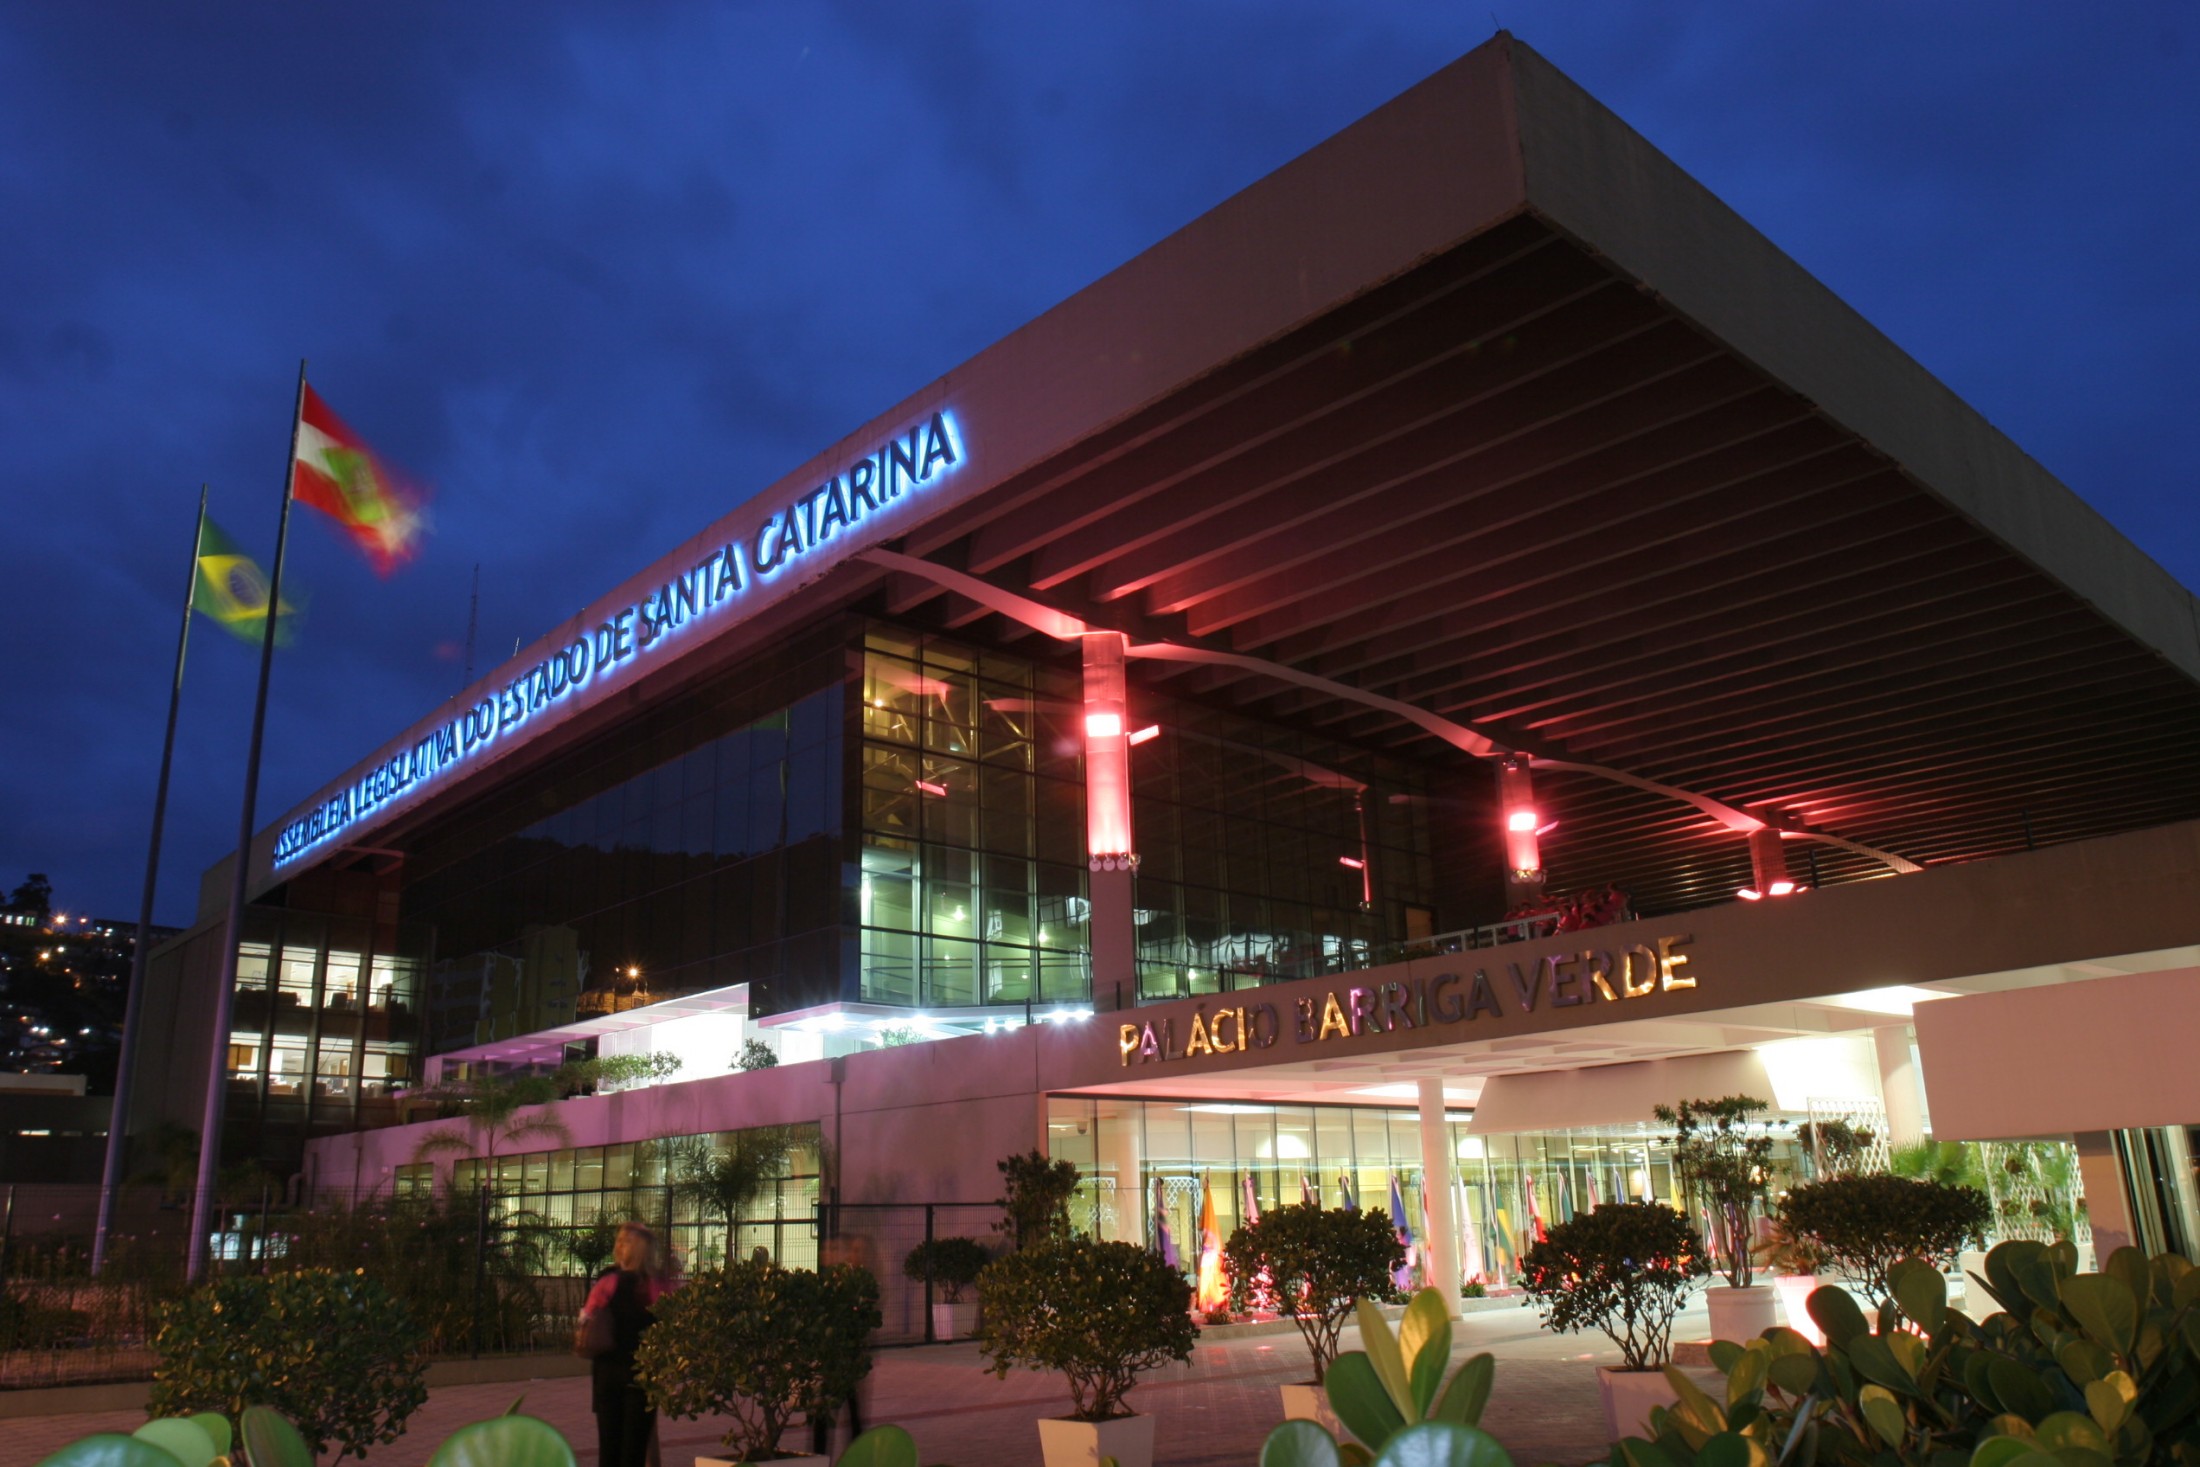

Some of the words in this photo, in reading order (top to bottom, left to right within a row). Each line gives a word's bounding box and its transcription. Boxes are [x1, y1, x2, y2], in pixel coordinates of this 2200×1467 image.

[354, 720, 458, 816] LEGISLATIVA
[463, 698, 495, 751] DO
[499, 637, 590, 731] ESTADO
[595, 608, 634, 673] DE
[638, 544, 743, 647] SANTA
[752, 412, 957, 574] CATARINA
[1119, 1002, 1279, 1067] PALÁCIO
[1294, 967, 1503, 1045] BARRIGA
[1507, 933, 1697, 1013] VERDE
